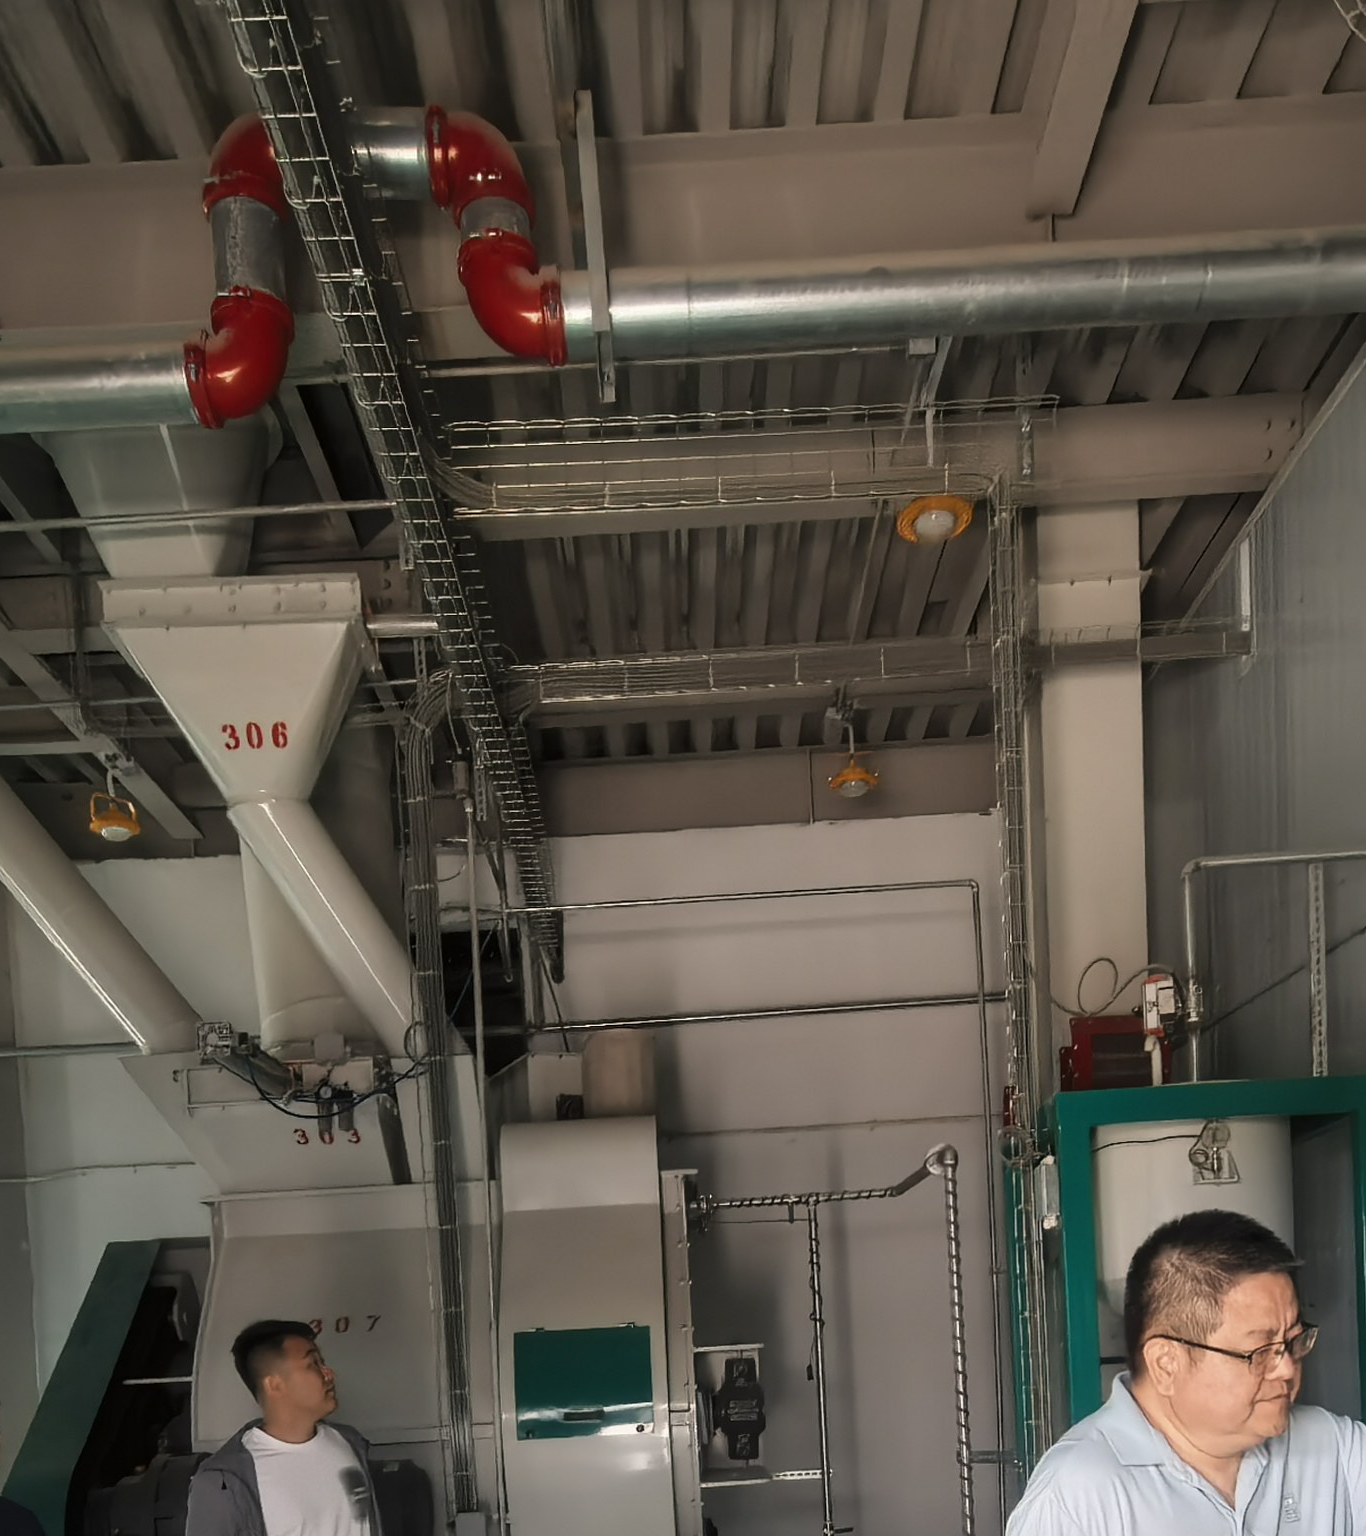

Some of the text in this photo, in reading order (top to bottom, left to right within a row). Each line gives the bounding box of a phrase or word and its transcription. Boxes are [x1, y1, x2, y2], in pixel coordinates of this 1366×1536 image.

[221, 721, 288, 750] 306
[293, 1128, 361, 1145] 303
[309, 1315, 381, 1334] 307
